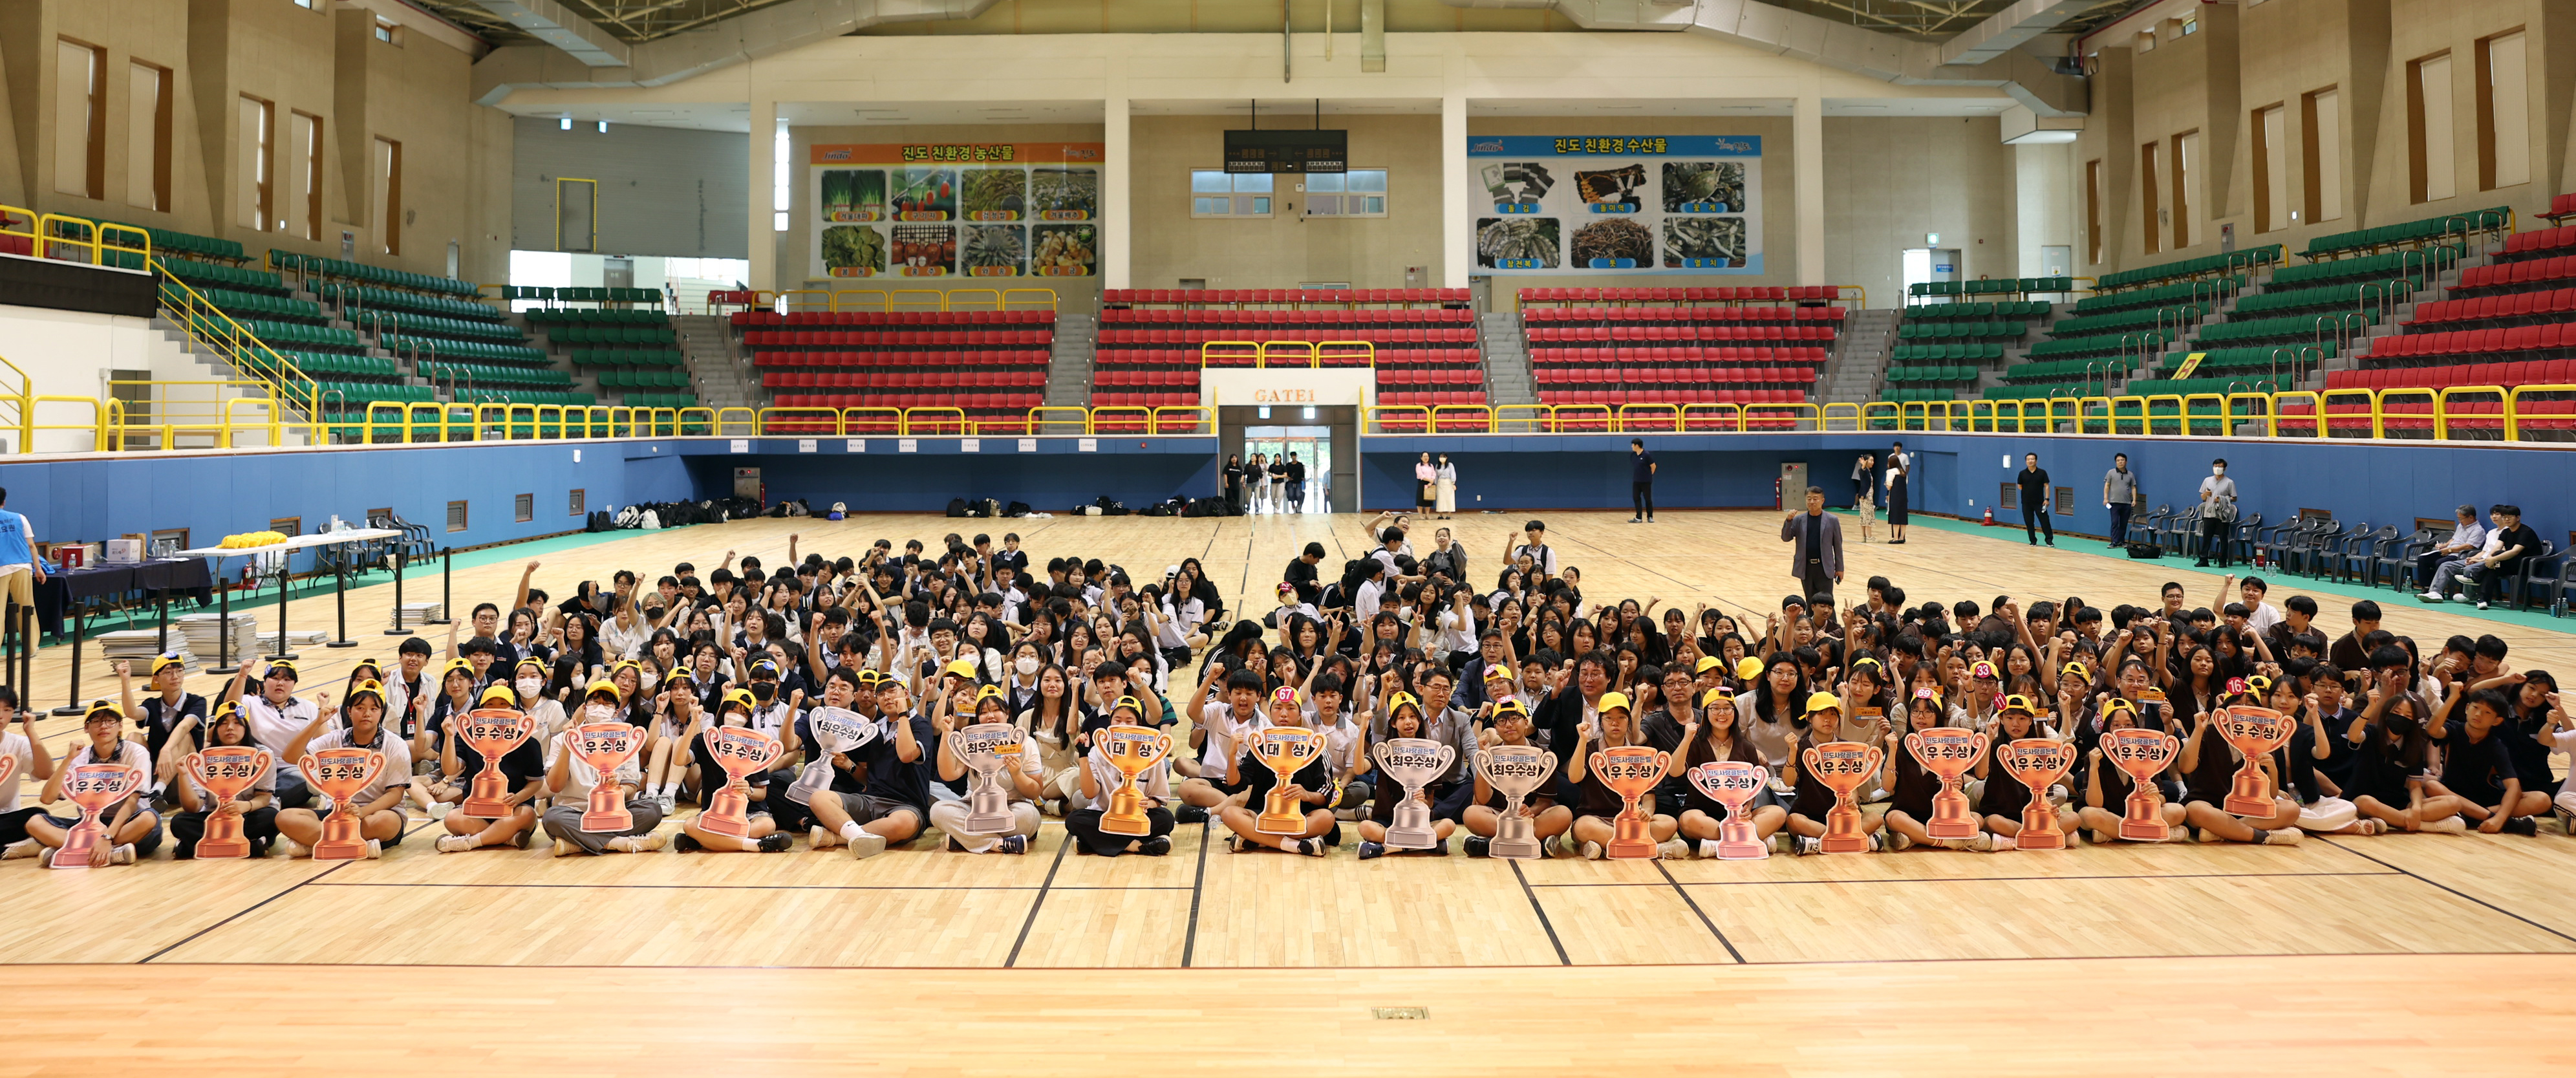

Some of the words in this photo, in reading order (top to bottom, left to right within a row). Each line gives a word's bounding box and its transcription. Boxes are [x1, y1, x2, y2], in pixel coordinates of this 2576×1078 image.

[1471, 143, 1499, 153] Jindo
[1555, 139, 1580, 153] 진도
[1585, 139, 1624, 153] 친환경
[1627, 138, 1667, 153] 수산물
[823, 151, 848, 160] Jindo
[903, 146, 928, 160] 진도
[932, 146, 971, 160] 친환경
[975, 145, 1014, 160] 농산물
[1508, 204, 1529, 213] 돌김
[1693, 204, 1716, 212] 꽃게
[1695, 259, 1717, 267] 멸치
[1255, 389, 1315, 402] GATE1
[1485, 665, 1496, 674] 43
[1977, 665, 1990, 676] 33
[2229, 679, 2243, 693] 16
[1280, 688, 1293, 700] 67
[1916, 689, 1933, 698] 69
[1995, 695, 2005, 708] 11
[237, 707, 245, 717] 10
[828, 714, 862, 728] 진도사랑골든벨
[2233, 715, 2276, 724] 진도사랑골든벨
[475, 726, 515, 739] 우수상
[821, 722, 858, 739] 최우수상
[2233, 724, 2275, 739] 우수상
[725, 734, 764, 748] 진도사랑골든벨
[1113, 733, 1154, 742] 진도사랑골든벨
[585, 740, 627, 753] 우수상
[722, 743, 761, 760] 우수상
[1927, 746, 1968, 759] 우수상
[2121, 747, 2160, 760] 우수상
[1393, 756, 1435, 768] 최우수상
[1823, 761, 1863, 774] 우수상
[2018, 757, 2057, 770] 우수상
[206, 765, 248, 777] 우수상
[320, 767, 363, 780] 우수상
[1494, 764, 1536, 776] 최우수상
[1611, 766, 1651, 779] 우수상
[76, 781, 122, 792] 우수상
[1710, 779, 1749, 789] 우수상
